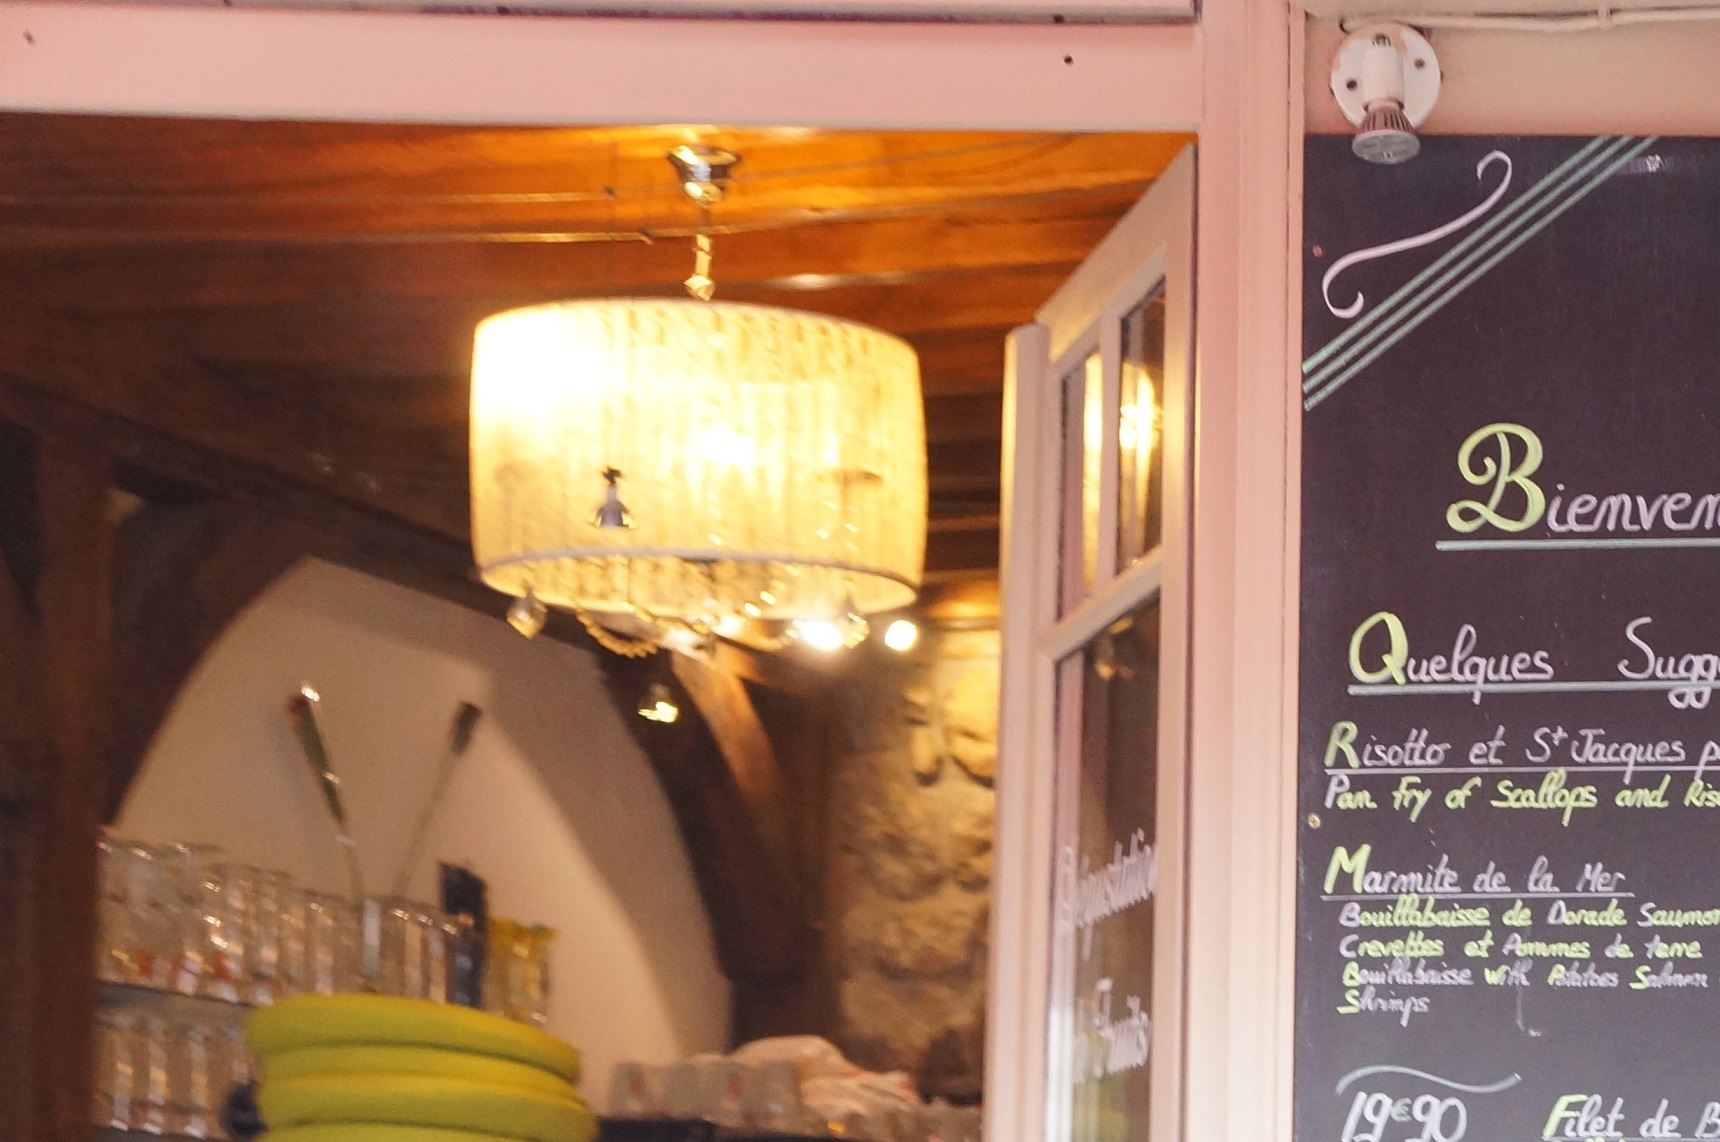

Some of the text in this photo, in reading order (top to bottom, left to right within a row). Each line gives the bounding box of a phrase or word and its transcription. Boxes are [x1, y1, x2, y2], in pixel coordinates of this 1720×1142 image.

[1348, 611, 1554, 705] Quelques
[1324, 721, 1452, 768] Risotto
[1469, 724, 1506, 766] et
[1571, 728, 1686, 785] Jacques
[1324, 773, 1377, 809] Pan
[1445, 776, 1482, 809] of
[1490, 767, 1598, 827] Scallops
[1614, 774, 1670, 808] and
[1323, 843, 1626, 894] Marmite de la Mer
[1338, 893, 1491, 927] Bouillabaisse
[1502, 899, 1532, 927] de
[1546, 898, 1627, 926] Dorade
[1338, 929, 1703, 959] Crevettes et Pommes de terre
[1543, 1093, 1625, 1139] Filet
[1639, 1098, 1681, 1139] de
